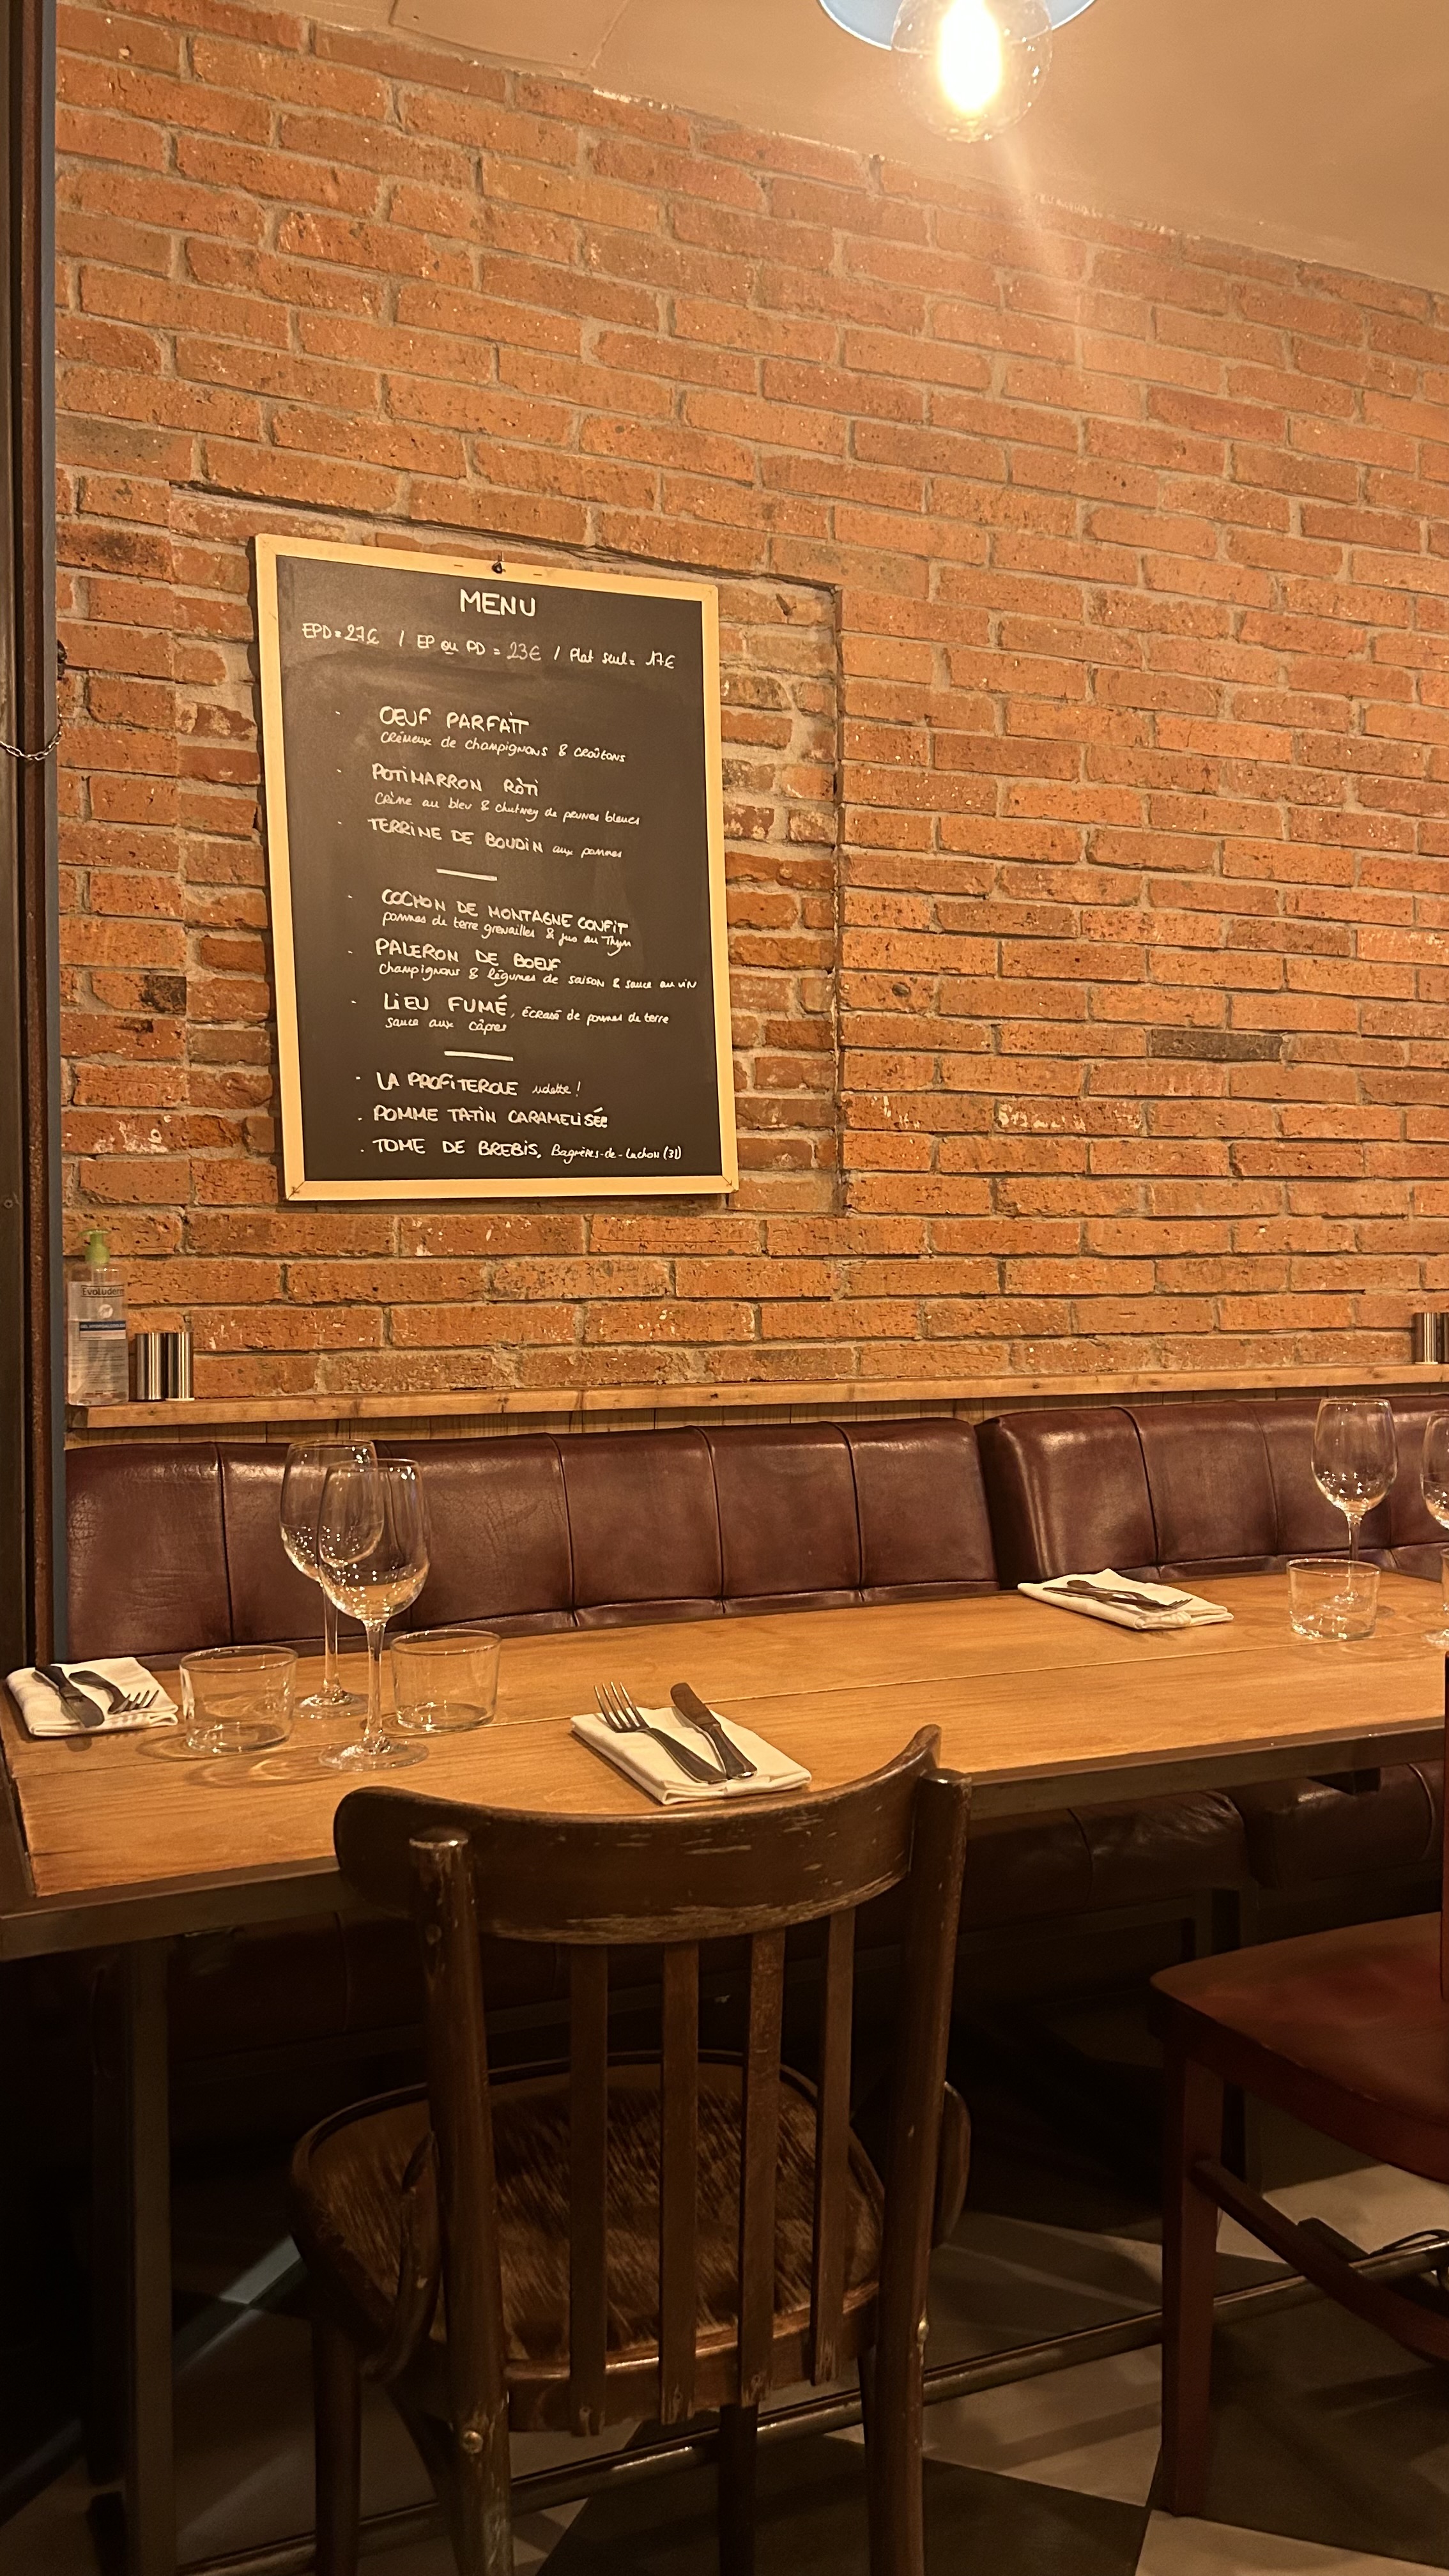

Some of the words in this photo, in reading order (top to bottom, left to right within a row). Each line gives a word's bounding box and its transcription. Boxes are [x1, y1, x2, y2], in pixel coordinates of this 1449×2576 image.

[461, 589, 535, 617] MENU
[570, 648, 594, 663] Plat
[441, 736, 456, 747] de
[558, 744, 568, 756] &
[481, 800, 489, 811] &
[544, 808, 557, 817] de
[451, 830, 474, 845] DE
[553, 846, 572, 857] aux
[382, 889, 446, 911] COCHON
[456, 901, 478, 917] DE
[488, 905, 573, 928] MONTAGNE
[432, 914, 447, 926] de
[454, 917, 478, 930] terre
[558, 933, 577, 946] jus
[583, 935, 598, 944] au
[376, 938, 459, 962] PALERON
[475, 949, 499, 966] DE
[469, 967, 479, 979] &
[543, 974, 558, 984] de
[429, 1019, 454, 1029] aux
[567, 1009, 580, 1020] de
[628, 1012, 641, 1022] de
[644, 1013, 669, 1023] terre
[376, 1072, 400, 1090] LA
[374, 1105, 438, 1121] POMME
[372, 1138, 425, 1154] TOME
[442, 1140, 465, 1154] DE
